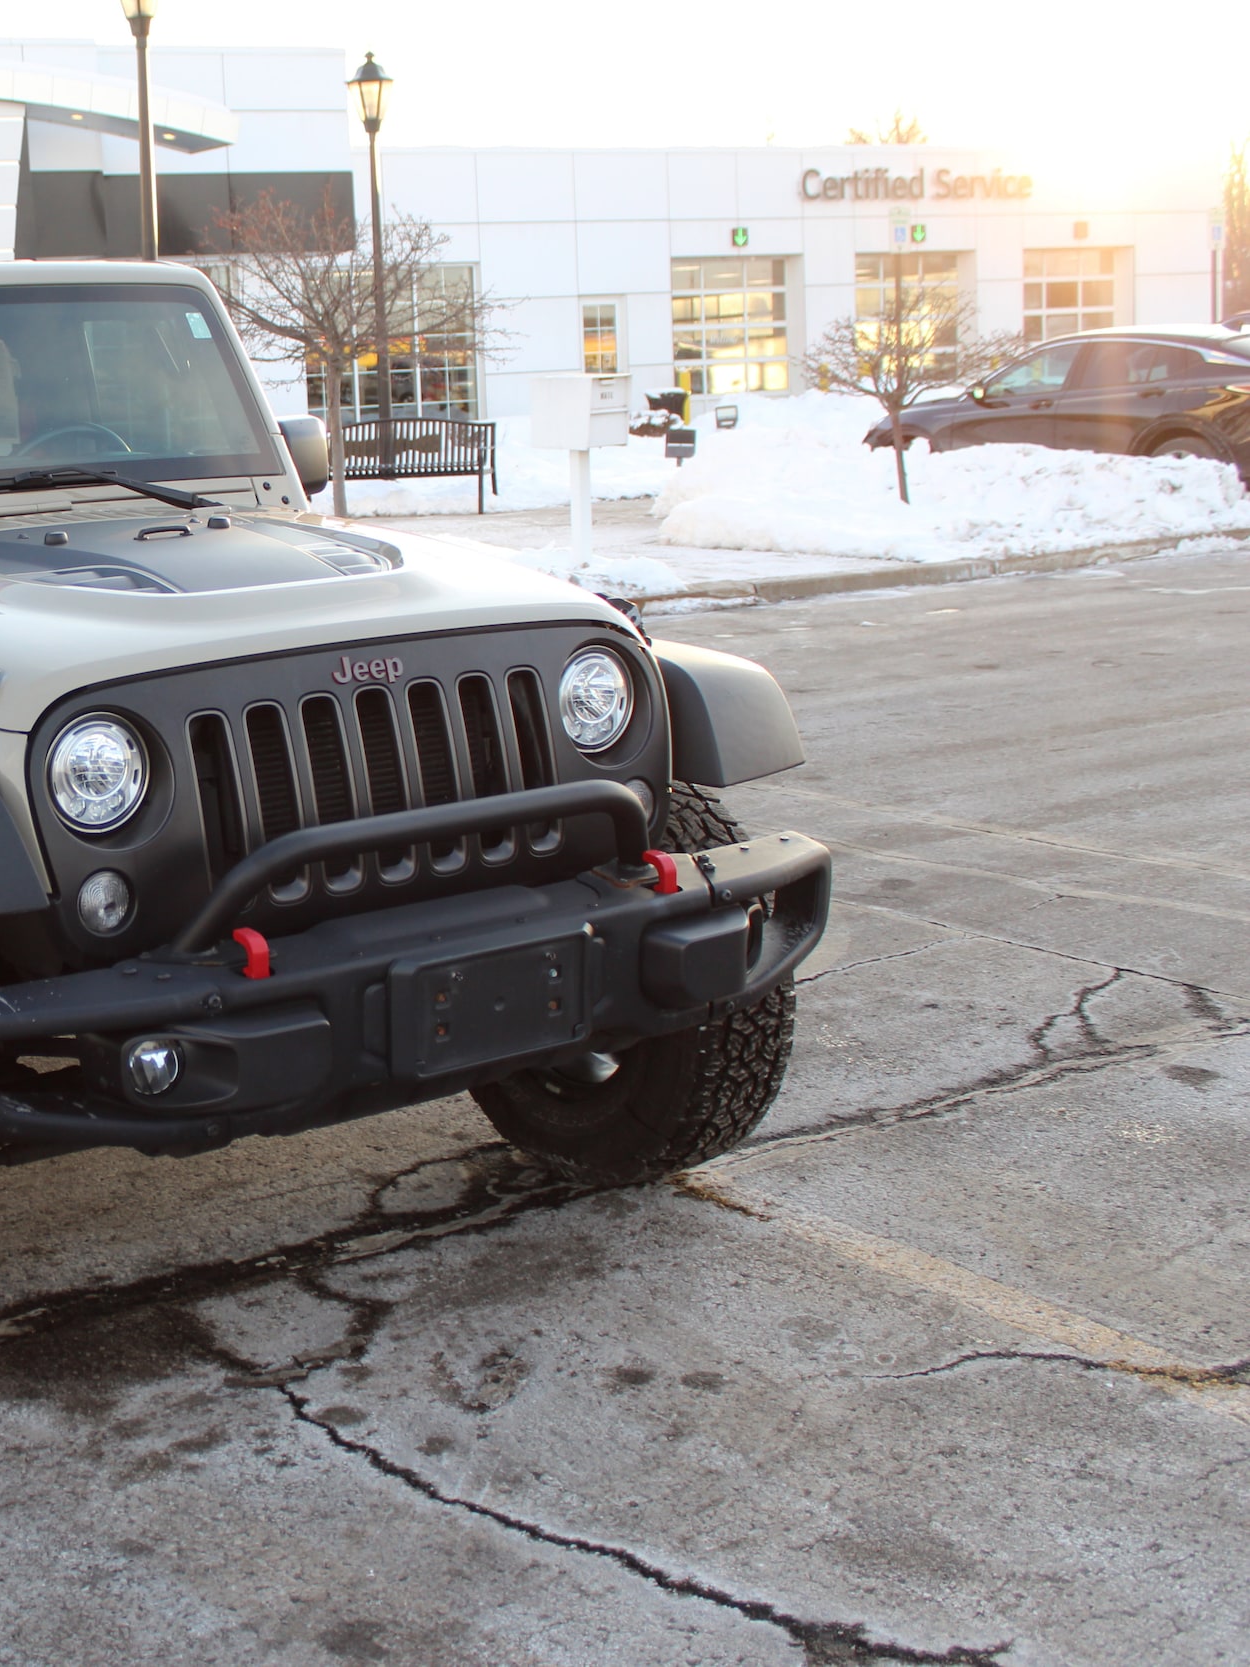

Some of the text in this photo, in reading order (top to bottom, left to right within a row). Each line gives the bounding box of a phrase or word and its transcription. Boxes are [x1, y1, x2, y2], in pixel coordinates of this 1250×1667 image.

[801, 168, 1033, 201] Certified Service
[331, 656, 403, 684] Jeep
